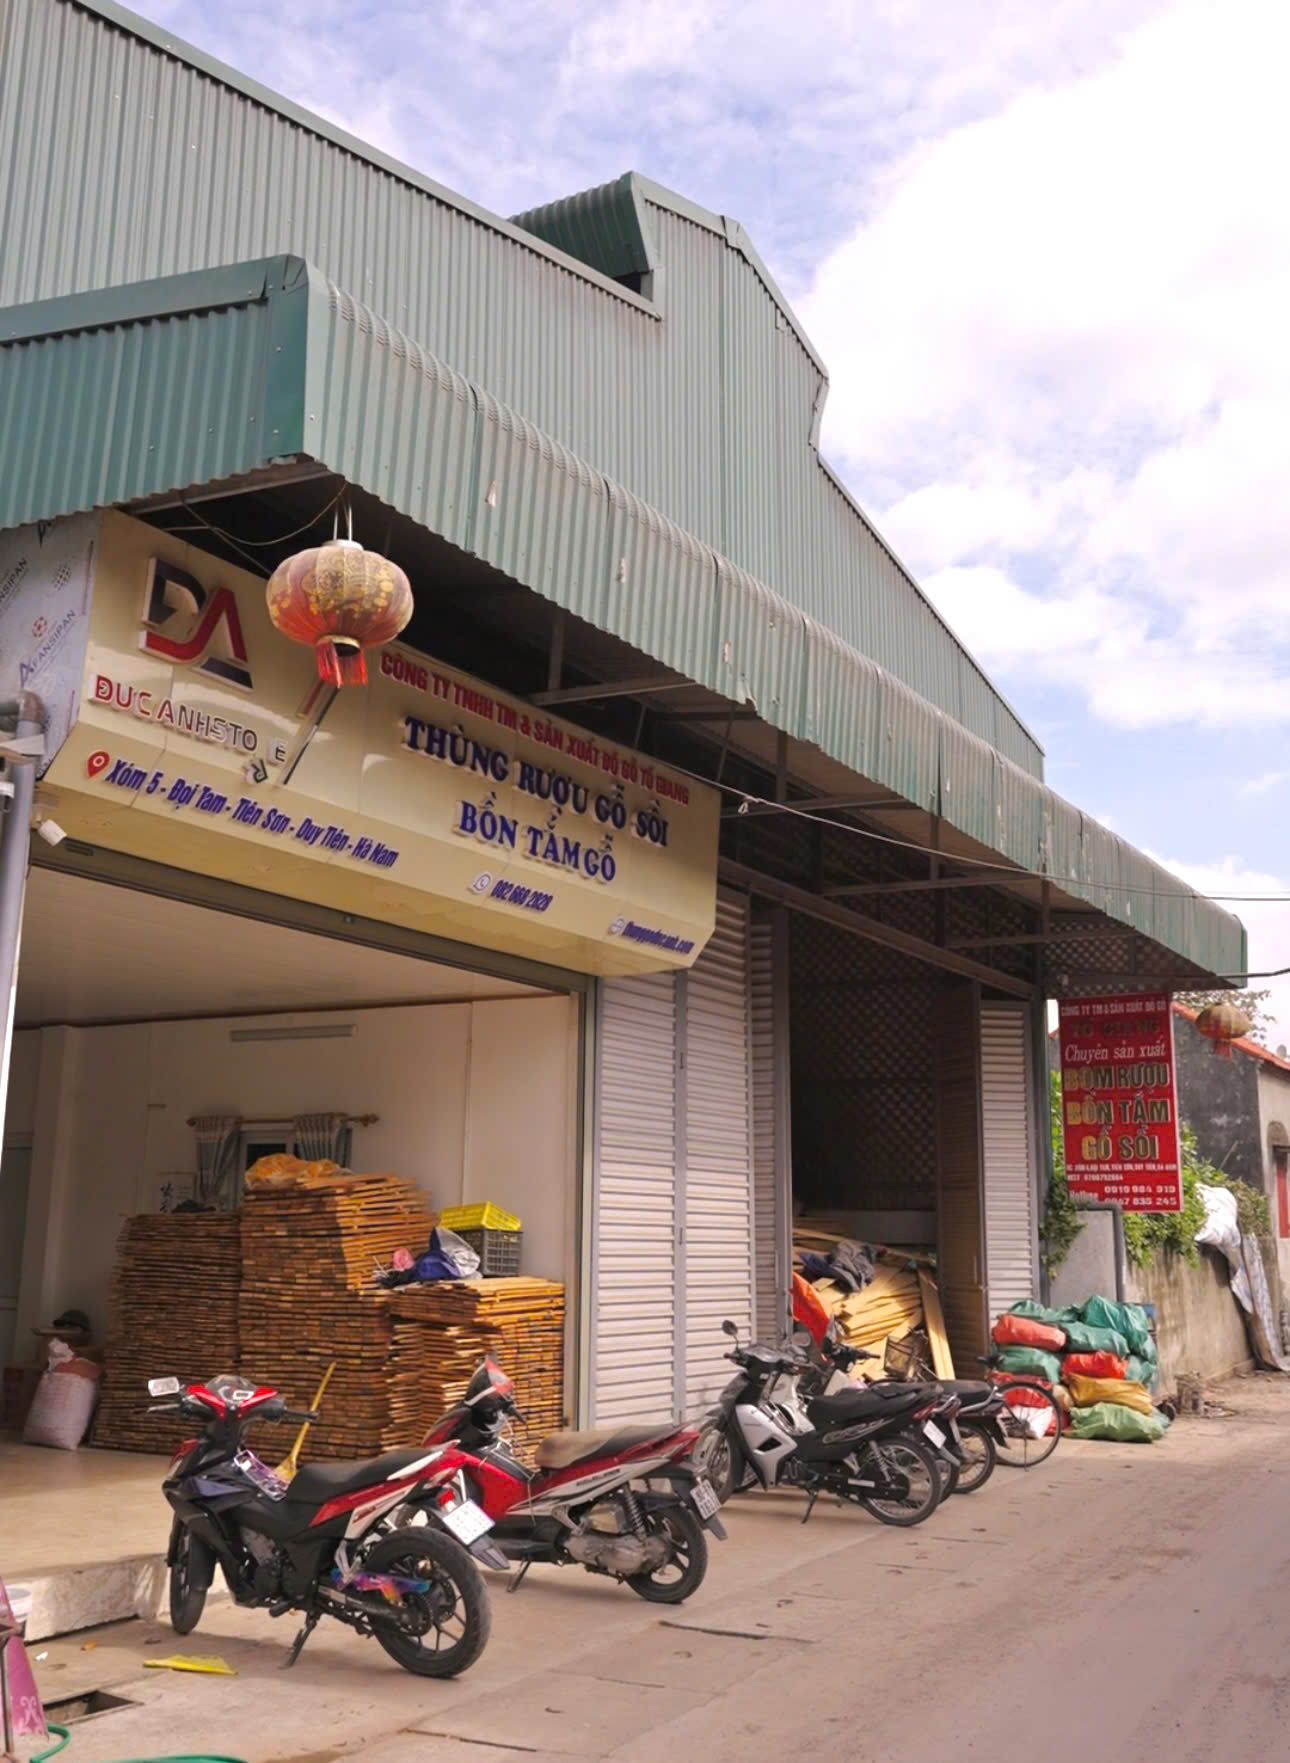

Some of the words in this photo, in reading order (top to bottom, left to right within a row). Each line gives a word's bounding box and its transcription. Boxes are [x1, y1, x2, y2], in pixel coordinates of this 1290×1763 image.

[381, 651, 428, 691] CÔNG
[431, 672, 450, 699] TY
[453, 682, 494, 720] TNHH
[496, 703, 518, 730] TM
[519, 715, 531, 736] &
[533, 717, 564, 750] SẢN
[105, 759, 147, 791] Xóm
[147, 771, 163, 795] 5
[195, 785, 228, 814] Tam
[232, 798, 264, 825] Tiên
[262, 807, 291, 835] Sơn
[295, 817, 324, 846] Duy
[320, 826, 349, 852] Tiên
[352, 836, 373, 860] Hà
[369, 841, 399, 868] Nam
[403, 715, 509, 782] THÙNG
[516, 760, 589, 817] RƯỢU
[594, 783, 628, 830] GỖ
[634, 798, 669, 847] SỒI
[458, 791, 518, 849] BỒN
[526, 814, 581, 870] TẮM
[583, 832, 617, 882] GỖ
[1065, 1043, 1109, 1064] Chuyên
[1113, 1040, 1135, 1059] sản
[1139, 1035, 1166, 1057] xuất
[1117, 1063, 1170, 1094] RƯỢU
[1067, 1089, 1114, 1125] BỒN
[1119, 1091, 1171, 1124] TẮM
